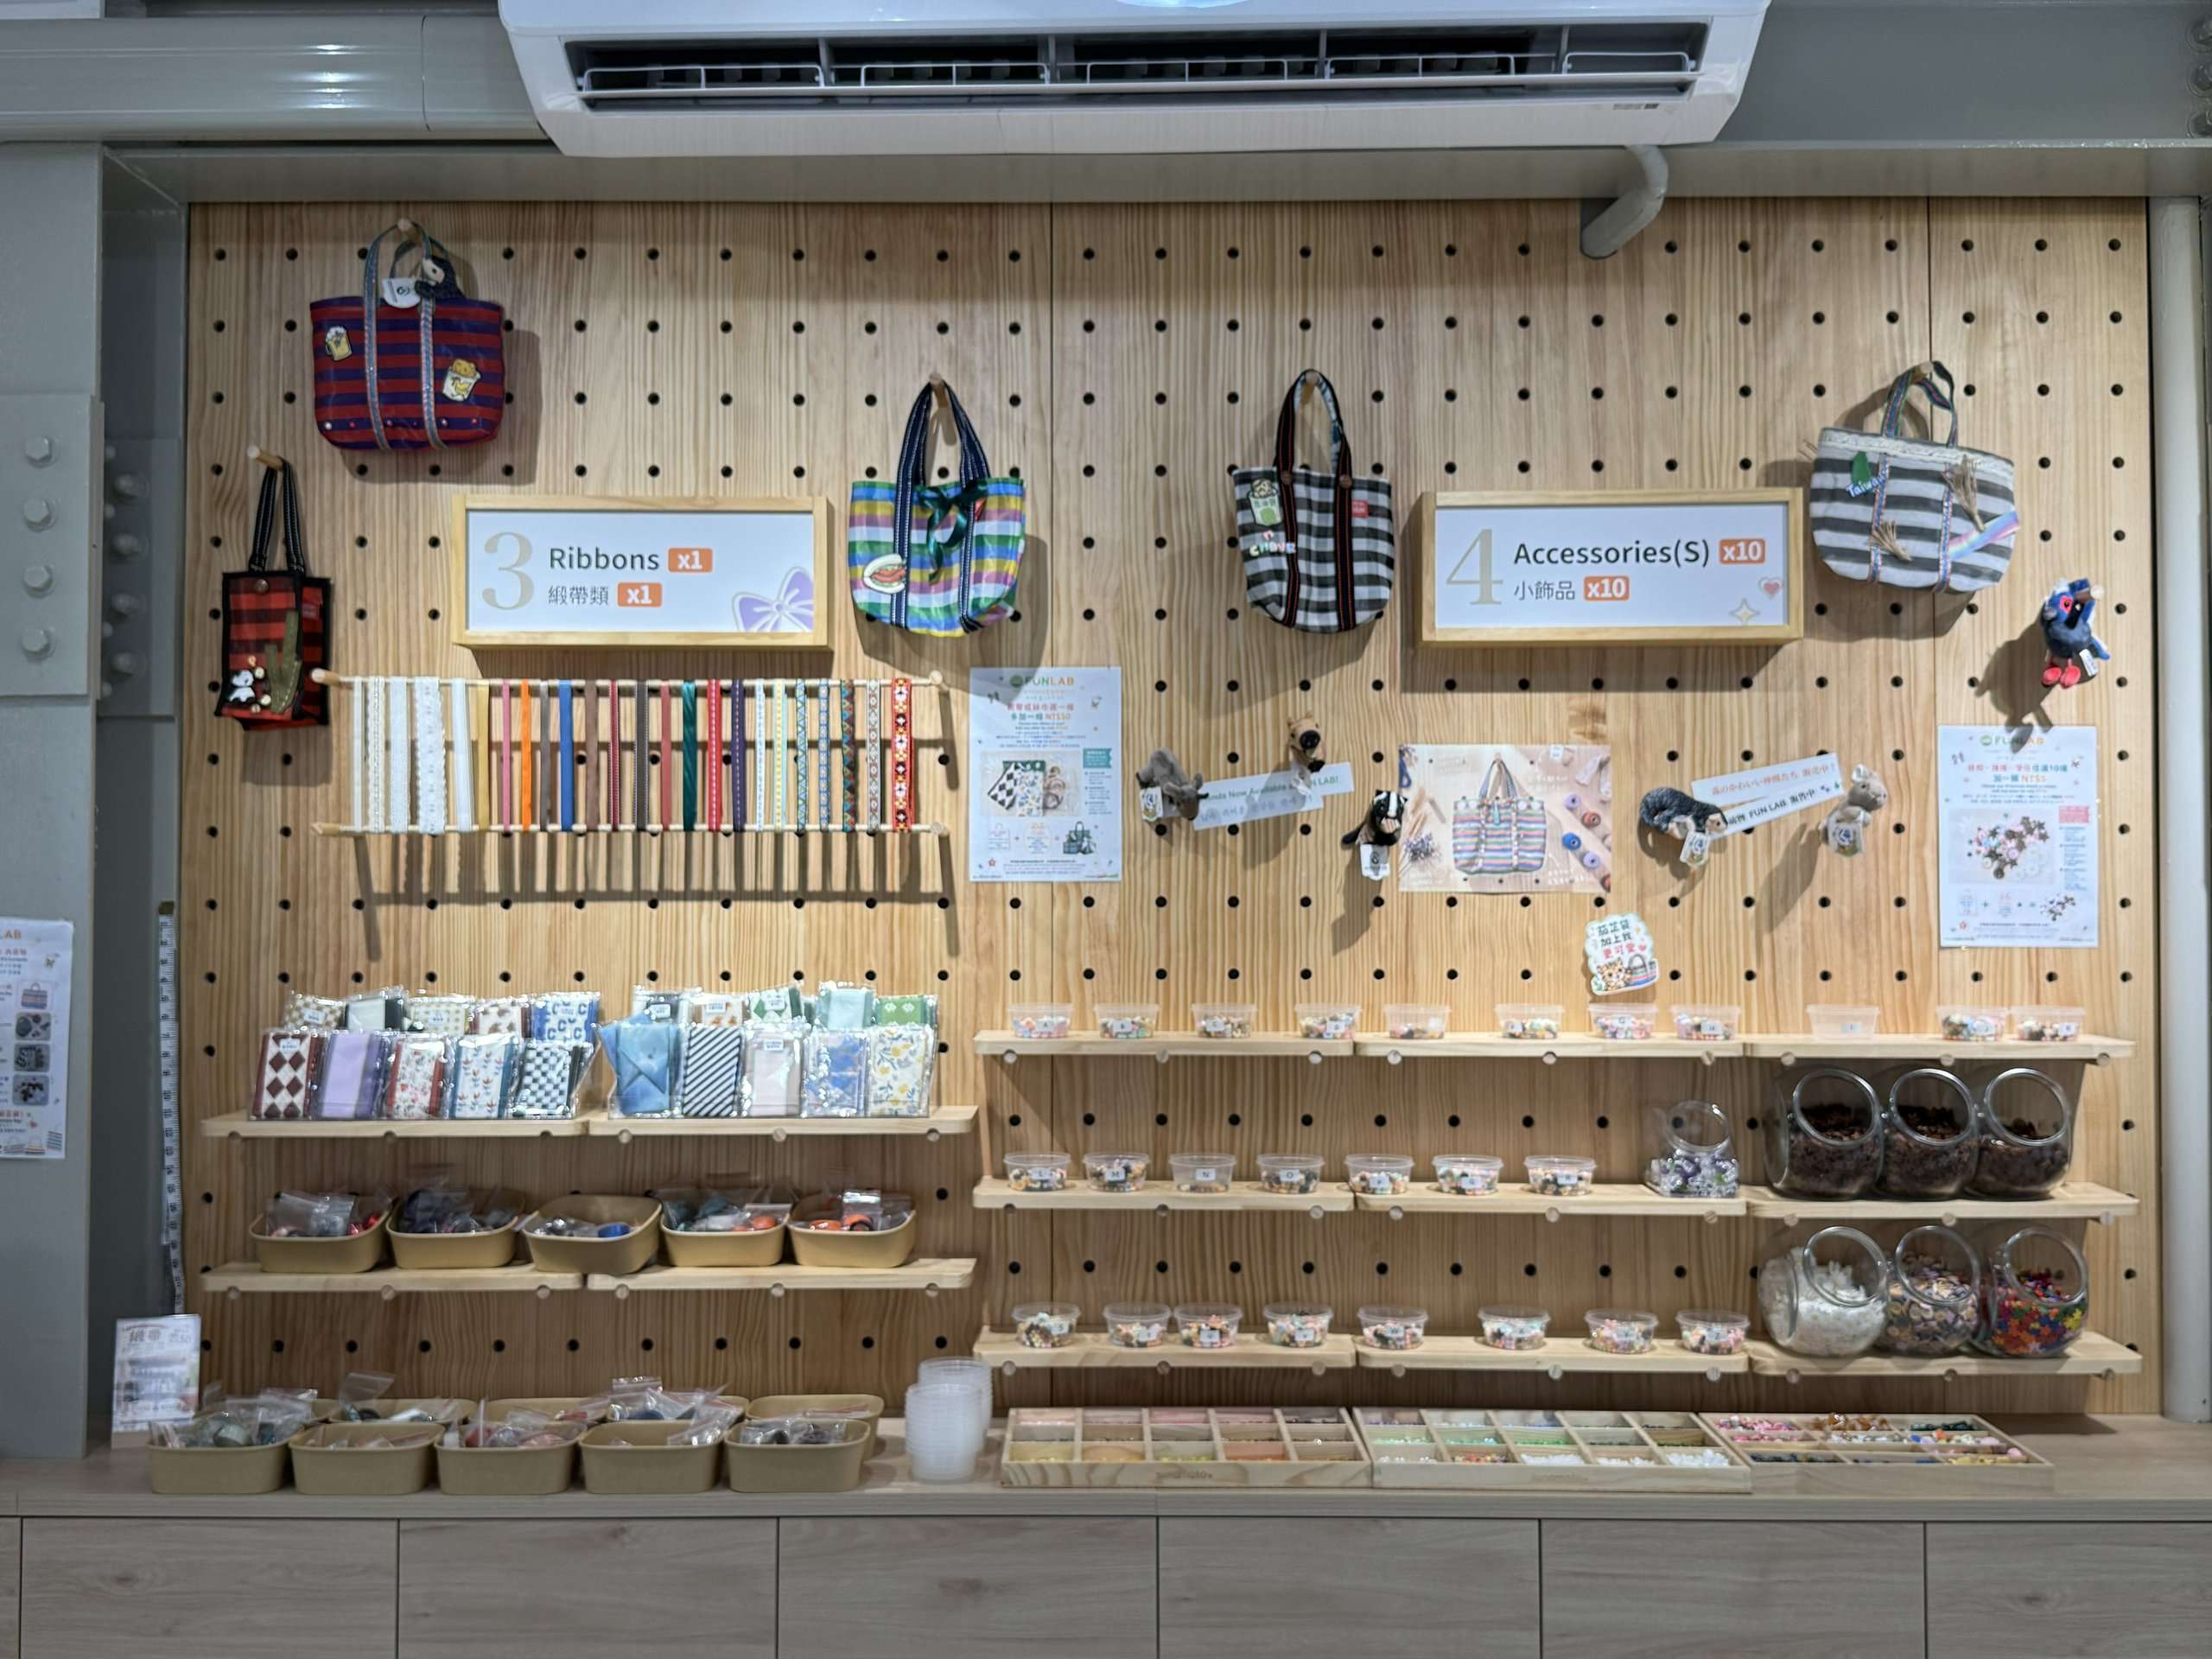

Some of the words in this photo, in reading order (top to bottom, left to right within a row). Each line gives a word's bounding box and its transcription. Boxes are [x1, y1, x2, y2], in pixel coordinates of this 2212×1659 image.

[549, 546, 660, 571] Ribbons
[677, 551, 703, 570] x1
[1513, 539, 1710, 568] Accessories(S)
[1722, 543, 1763, 562] x10
[481, 531, 535, 611] 3
[1446, 528, 1503, 605] 4
[548, 585, 609, 606] 緞帶類
[626, 585, 653, 605] x1
[1513, 580, 1576, 601] 小飾品
[1586, 581, 1626, 599] x10
[1994, 735, 2044, 746] FUAB
[1749, 806, 1768, 818] FUN
[1769, 800, 1786, 810] LAB
